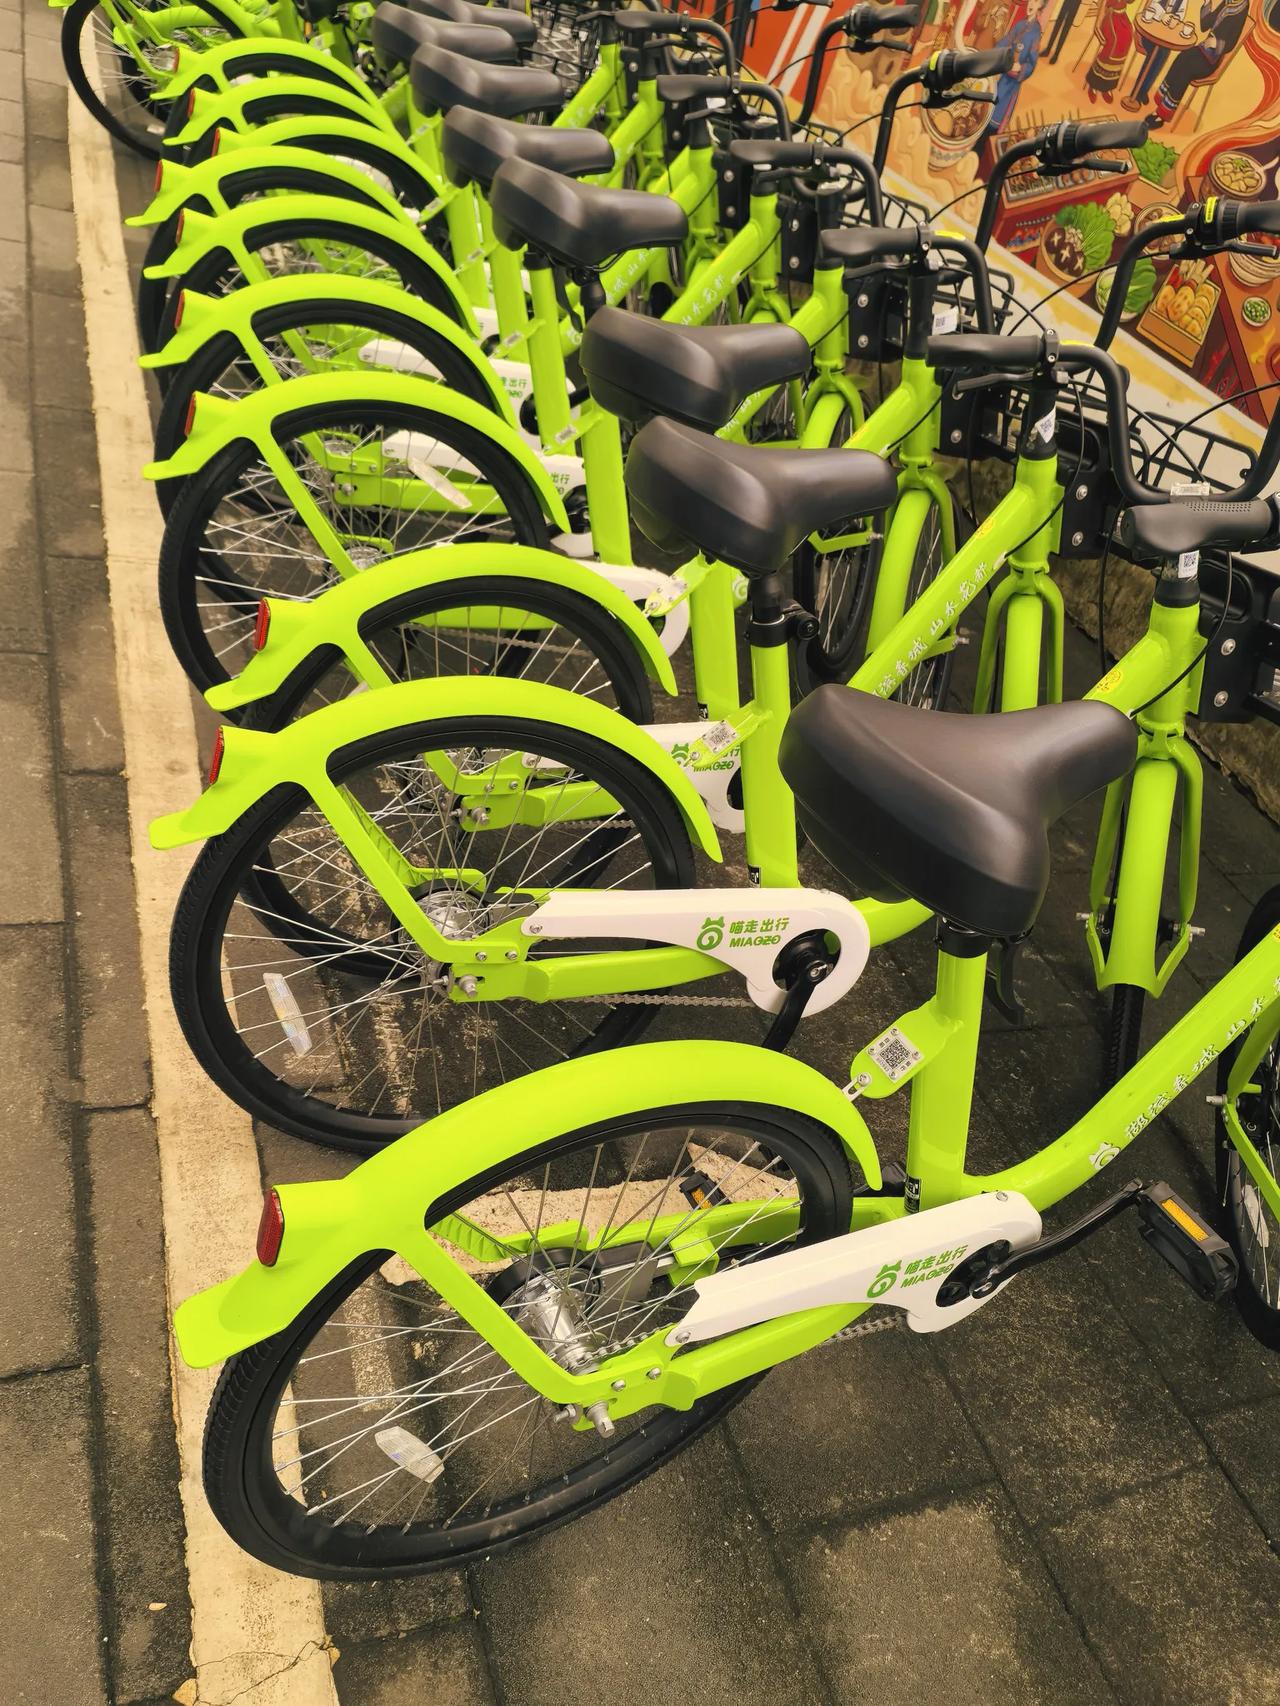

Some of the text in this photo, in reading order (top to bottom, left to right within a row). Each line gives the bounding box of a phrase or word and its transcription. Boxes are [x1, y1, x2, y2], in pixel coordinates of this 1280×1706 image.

[729, 917, 790, 934] 喵走出行
[904, 1244, 969, 1275] 喵走出行
